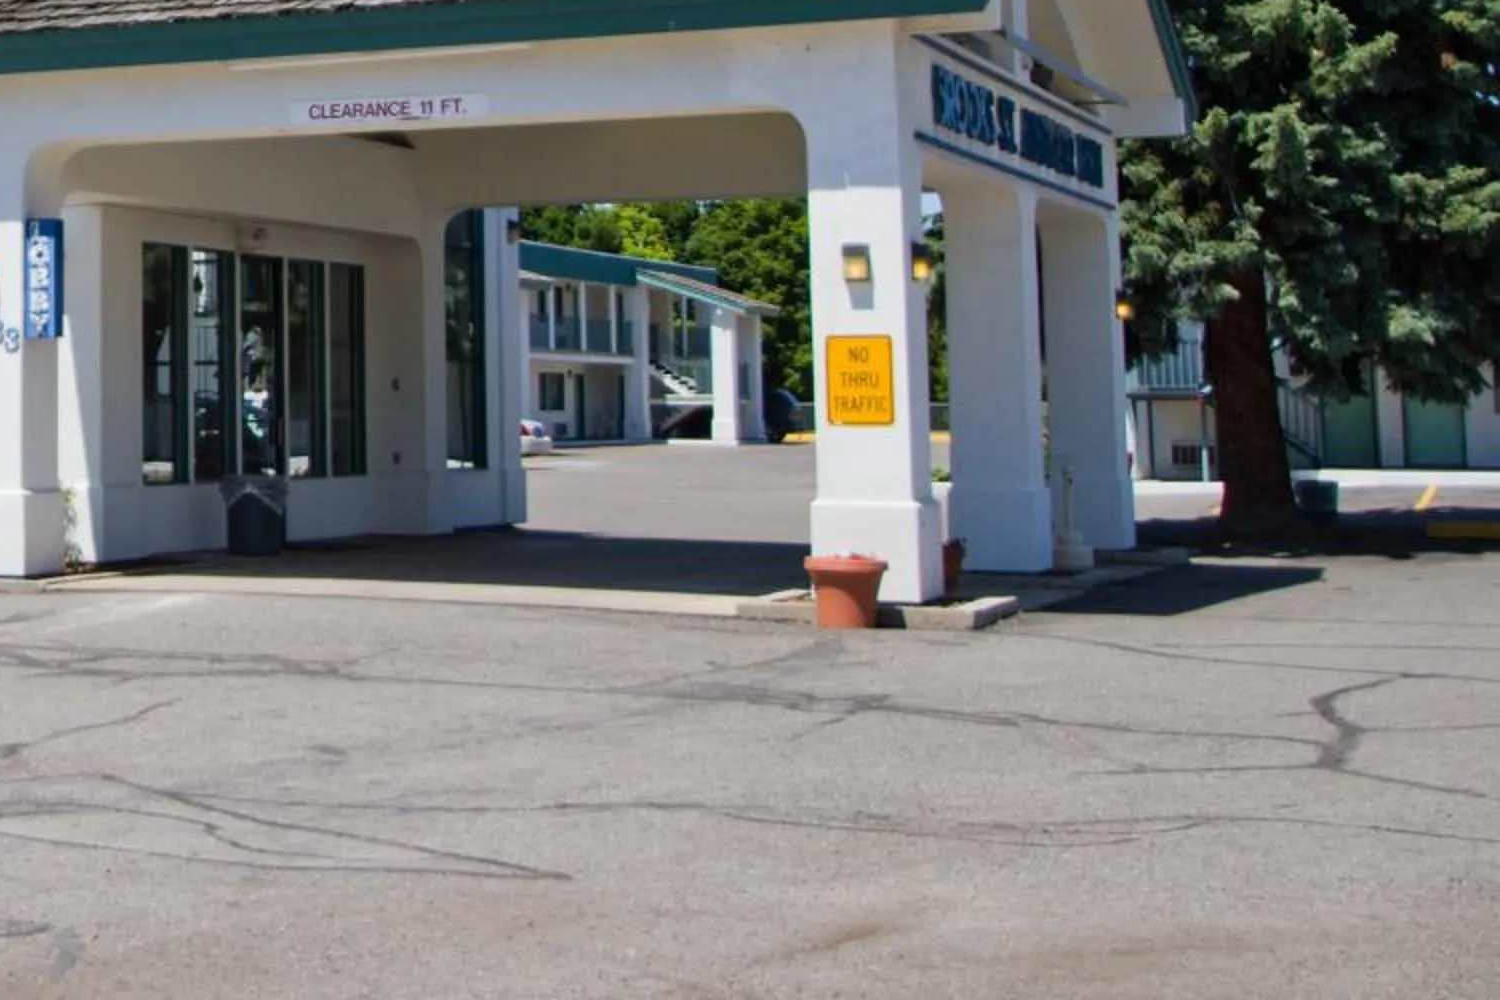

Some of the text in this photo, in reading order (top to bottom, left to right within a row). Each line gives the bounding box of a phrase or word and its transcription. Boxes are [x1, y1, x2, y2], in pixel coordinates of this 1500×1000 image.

[308, 97, 467, 120] CLEARANCE 11 FT.
[848, 346, 869, 363] NO
[840, 370, 879, 389] THRU
